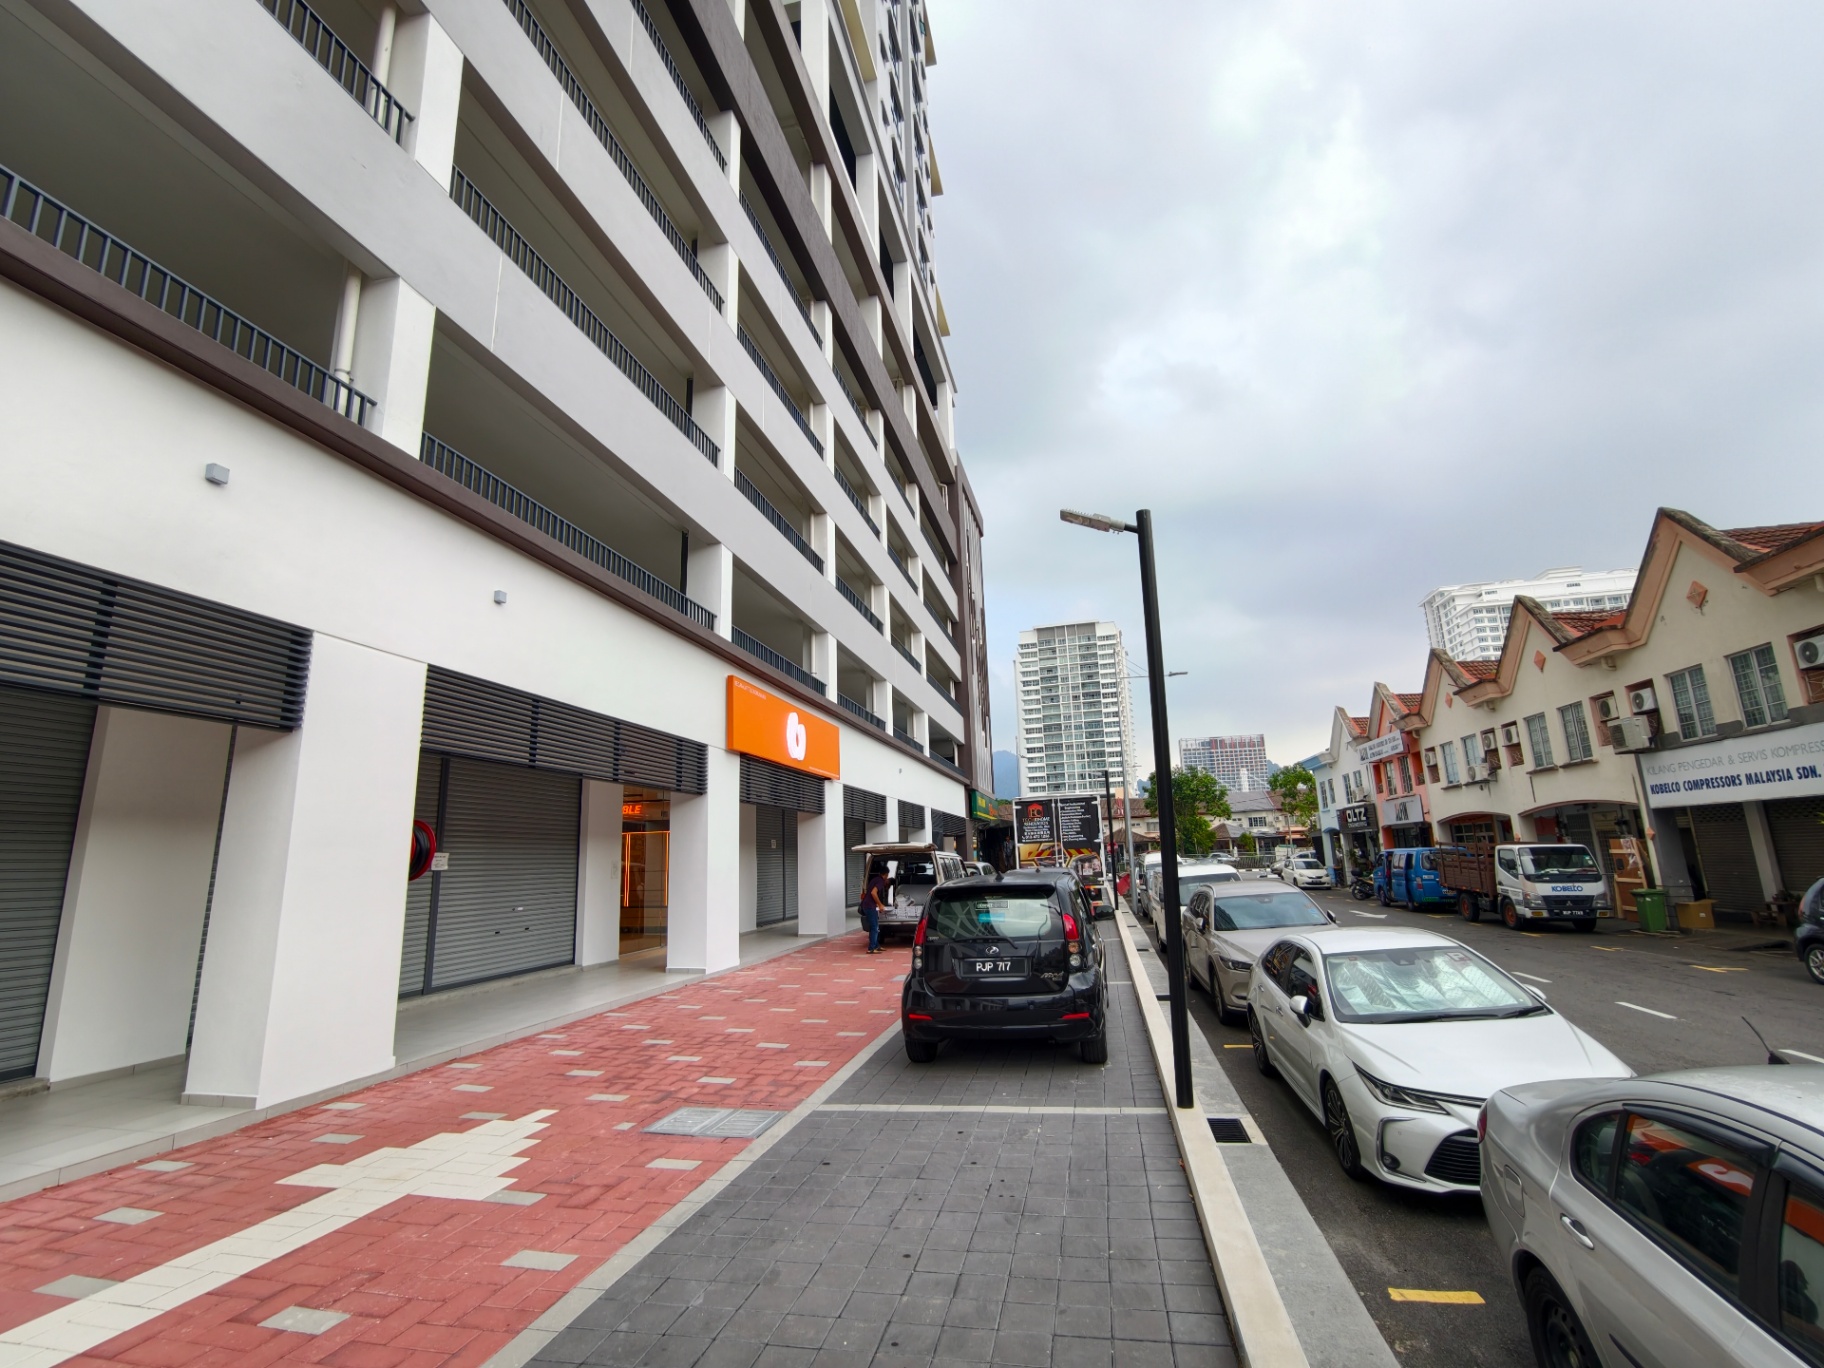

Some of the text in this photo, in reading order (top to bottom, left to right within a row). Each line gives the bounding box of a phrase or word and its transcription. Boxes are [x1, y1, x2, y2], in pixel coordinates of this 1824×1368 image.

[1646, 763, 1676, 776] KILANG
[1678, 756, 1725, 772] PENGEDAR
[1728, 755, 1736, 765] &
[1738, 749, 1768, 764] SERVIS
[1650, 765, 1822, 795] KOBELCO COMPRESSORS MALAYSIA SDN.
[976, 961, 1012, 972] PJP 717
